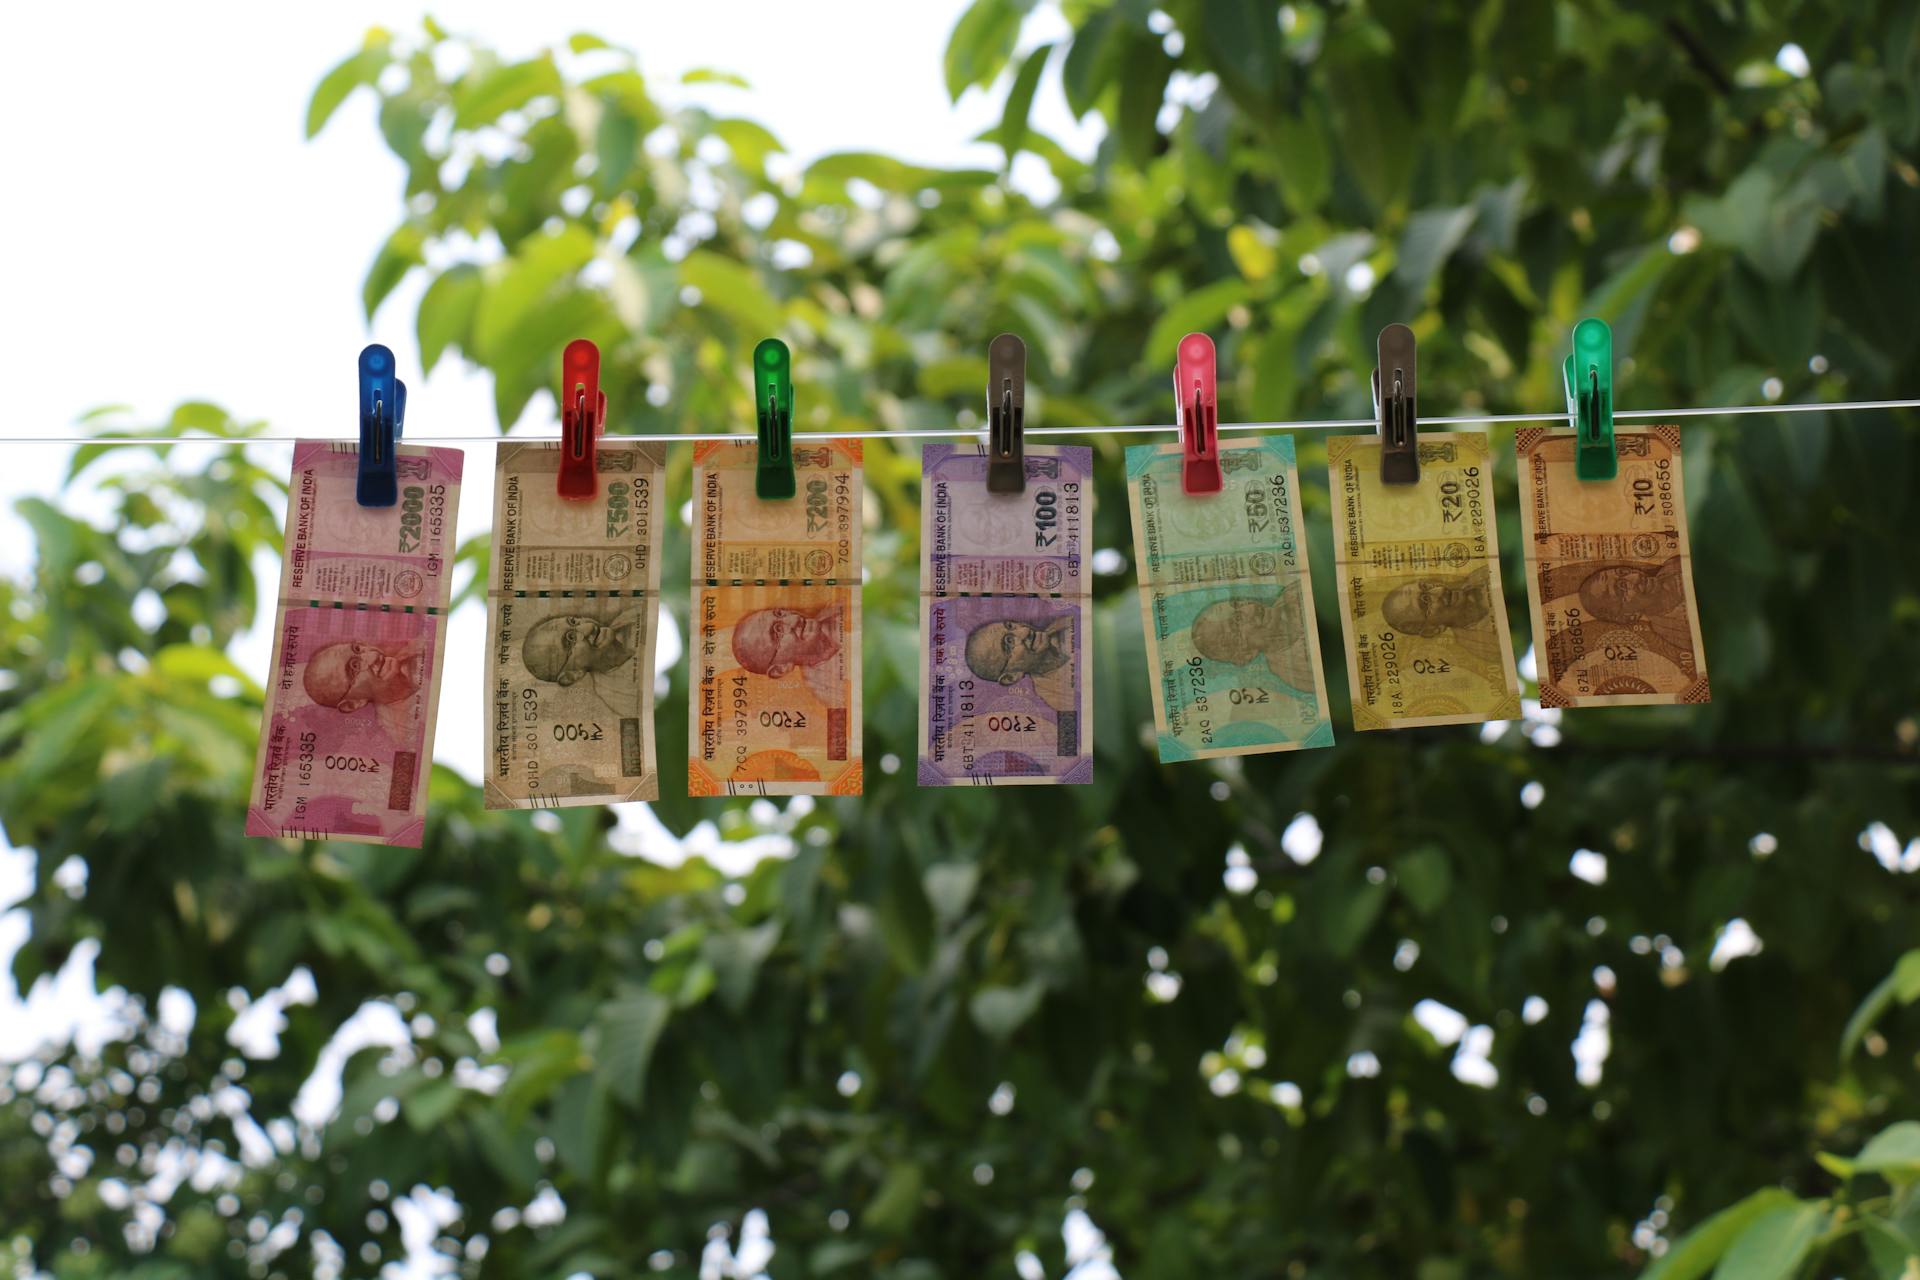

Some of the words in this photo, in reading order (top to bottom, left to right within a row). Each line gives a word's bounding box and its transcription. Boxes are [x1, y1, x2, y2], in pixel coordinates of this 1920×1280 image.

[1344, 459, 1353, 480] INDIA
[1534, 453, 1542, 473] INDIA
[302, 469, 313, 495] INDIA
[508, 476, 518, 500] INDIA
[707, 473, 717, 498] INDIA
[1346, 482, 1353, 493] OF
[1536, 475, 1543, 486] OF
[1655, 458, 1674, 516] 508656
[301, 498, 311, 510] OF
[634, 478, 649, 535] 301539
[707, 500, 716, 512] OF
[806, 480, 828, 533] ₹200
[835, 471, 850, 531] 397994
[937, 482, 946, 508] INDIA
[1270, 475, 1290, 534] 537236
[1347, 496, 1356, 518] BANK
[1441, 481, 1463, 524] ₹20
[1464, 467, 1483, 526] 229026
[1536, 487, 1544, 508] BANK
[1633, 479, 1655, 516] ₹10
[398, 486, 426, 554] ₹2000
[430, 484, 445, 542] 165335
[508, 503, 516, 516] OF
[606, 482, 630, 539] ₹500
[937, 510, 946, 523] OF
[1036, 492, 1057, 547] ₹100
[1064, 483, 1079, 542] 411813
[1246, 486, 1269, 533] ₹50
[298, 514, 309, 540] BANK
[506, 519, 516, 544] BANK
[707, 515, 716, 540] BANK
[1146, 512, 1155, 534] BANK
[1538, 510, 1548, 545] RESERVE
[838, 539, 849, 564] 7CQ
[937, 526, 946, 551] BANK
[1349, 520, 1358, 557] RESERVE
[293, 544, 306, 588] RESERVE
[1068, 551, 1079, 577] 6BT
[1150, 536, 1160, 572] RESERVE
[504, 547, 515, 591] RESERVE
[936, 554, 947, 597] RESERVE
[704, 625, 716, 638] सौ
[934, 634, 946, 646] सौ
[1565, 608, 1585, 662] 508656
[704, 642, 717, 655] दो
[934, 648, 945, 665] एक
[1379, 632, 1400, 685] 229026
[496, 679, 510, 699] बैंक
[703, 666, 716, 686] बैंक
[933, 675, 945, 693] बैंक
[1187, 656, 1208, 712] 537236
[1362, 676, 1376, 706] भारतीय
[523, 688, 538, 750] 301539
[733, 676, 748, 736] 397994
[959, 680, 975, 737] 411813
[760, 711, 806, 728] ₹२००
[1169, 705, 1183, 737] भारतीय
[1200, 719, 1213, 744] 2AQ
[271, 726, 286, 743] बैंक
[703, 721, 715, 761] भारतीय
[933, 726, 946, 762] भारतीय
[299, 732, 316, 786] 165335
[325, 755, 380, 773] ₹२०००
[497, 736, 510, 777] भारतीय
[736, 746, 747, 772] 7CQ
[963, 747, 974, 770] 6BT
[264, 774, 279, 811] भारतीय
